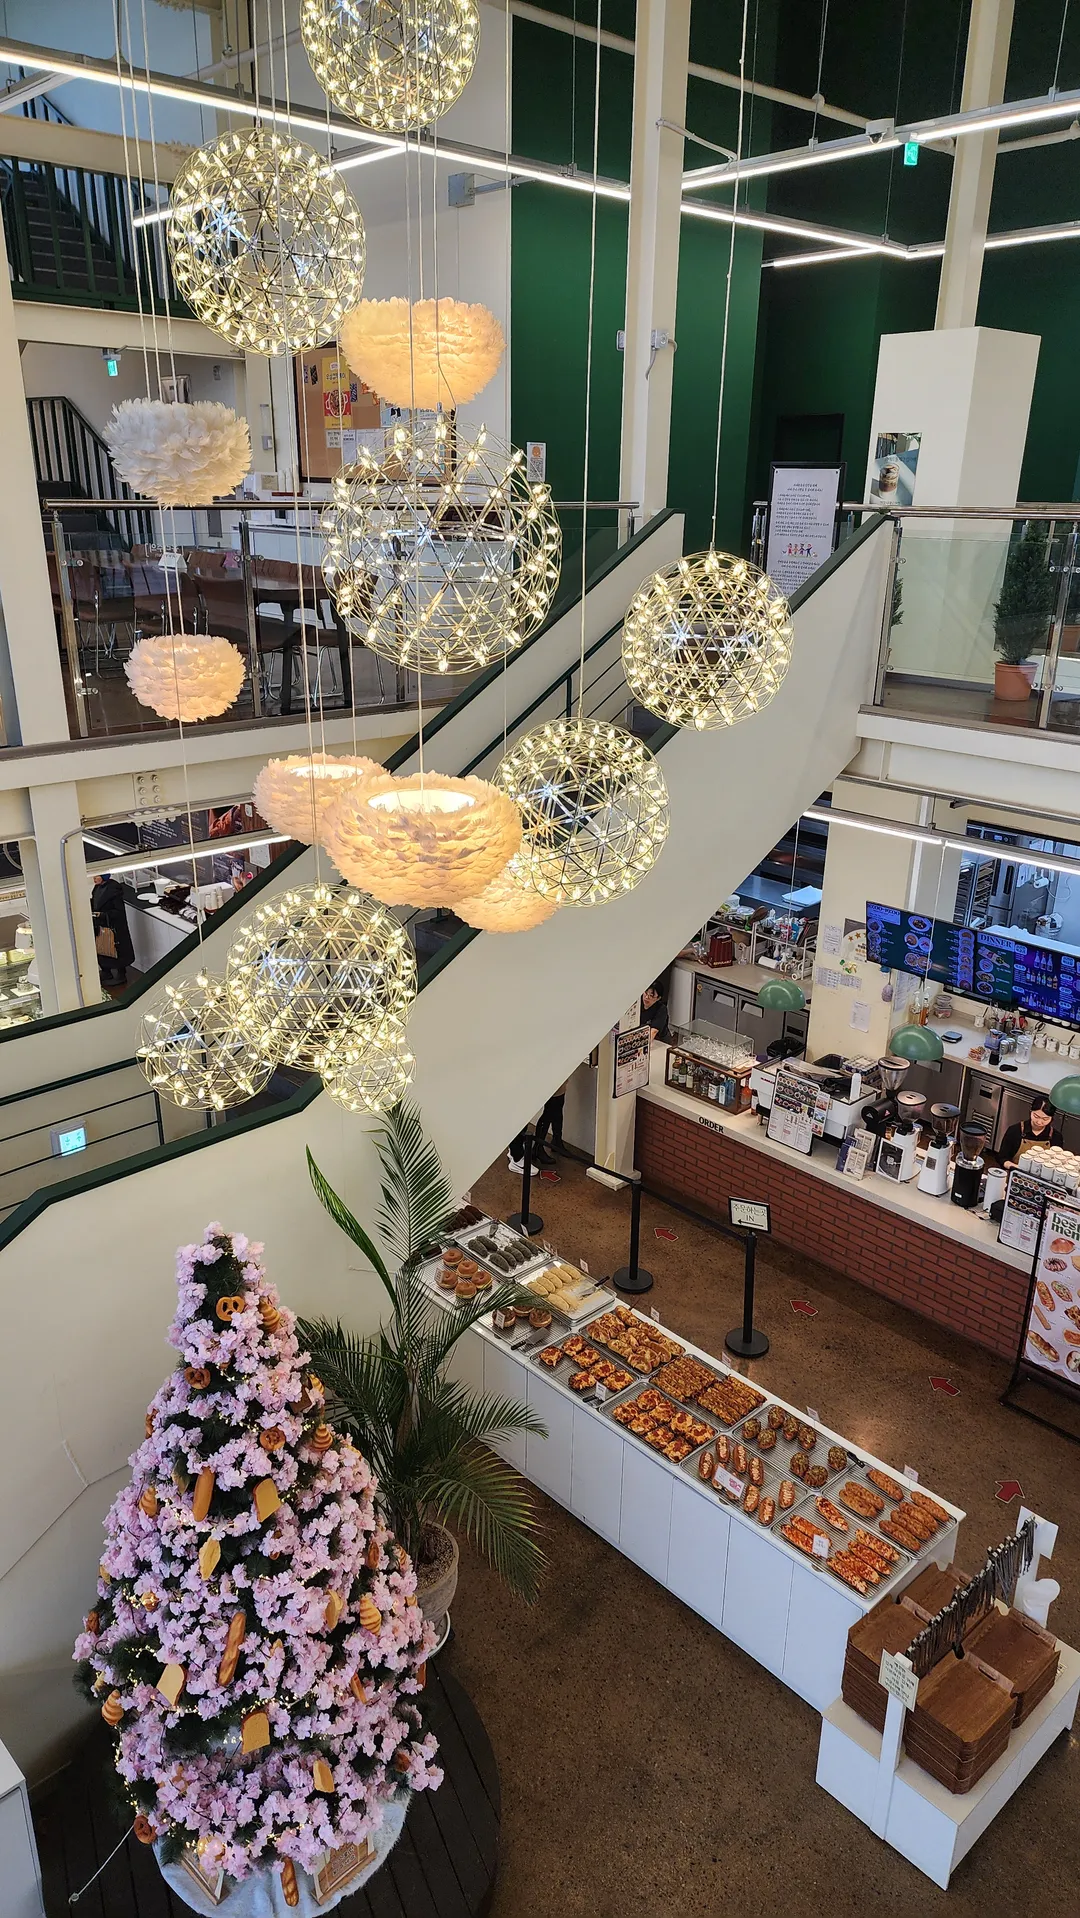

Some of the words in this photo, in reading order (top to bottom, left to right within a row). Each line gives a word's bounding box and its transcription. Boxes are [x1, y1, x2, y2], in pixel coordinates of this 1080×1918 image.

[980, 934, 1012, 948] DINNER
[698, 1116, 724, 1134] ORDER
[746, 1214, 755, 1222] IN
